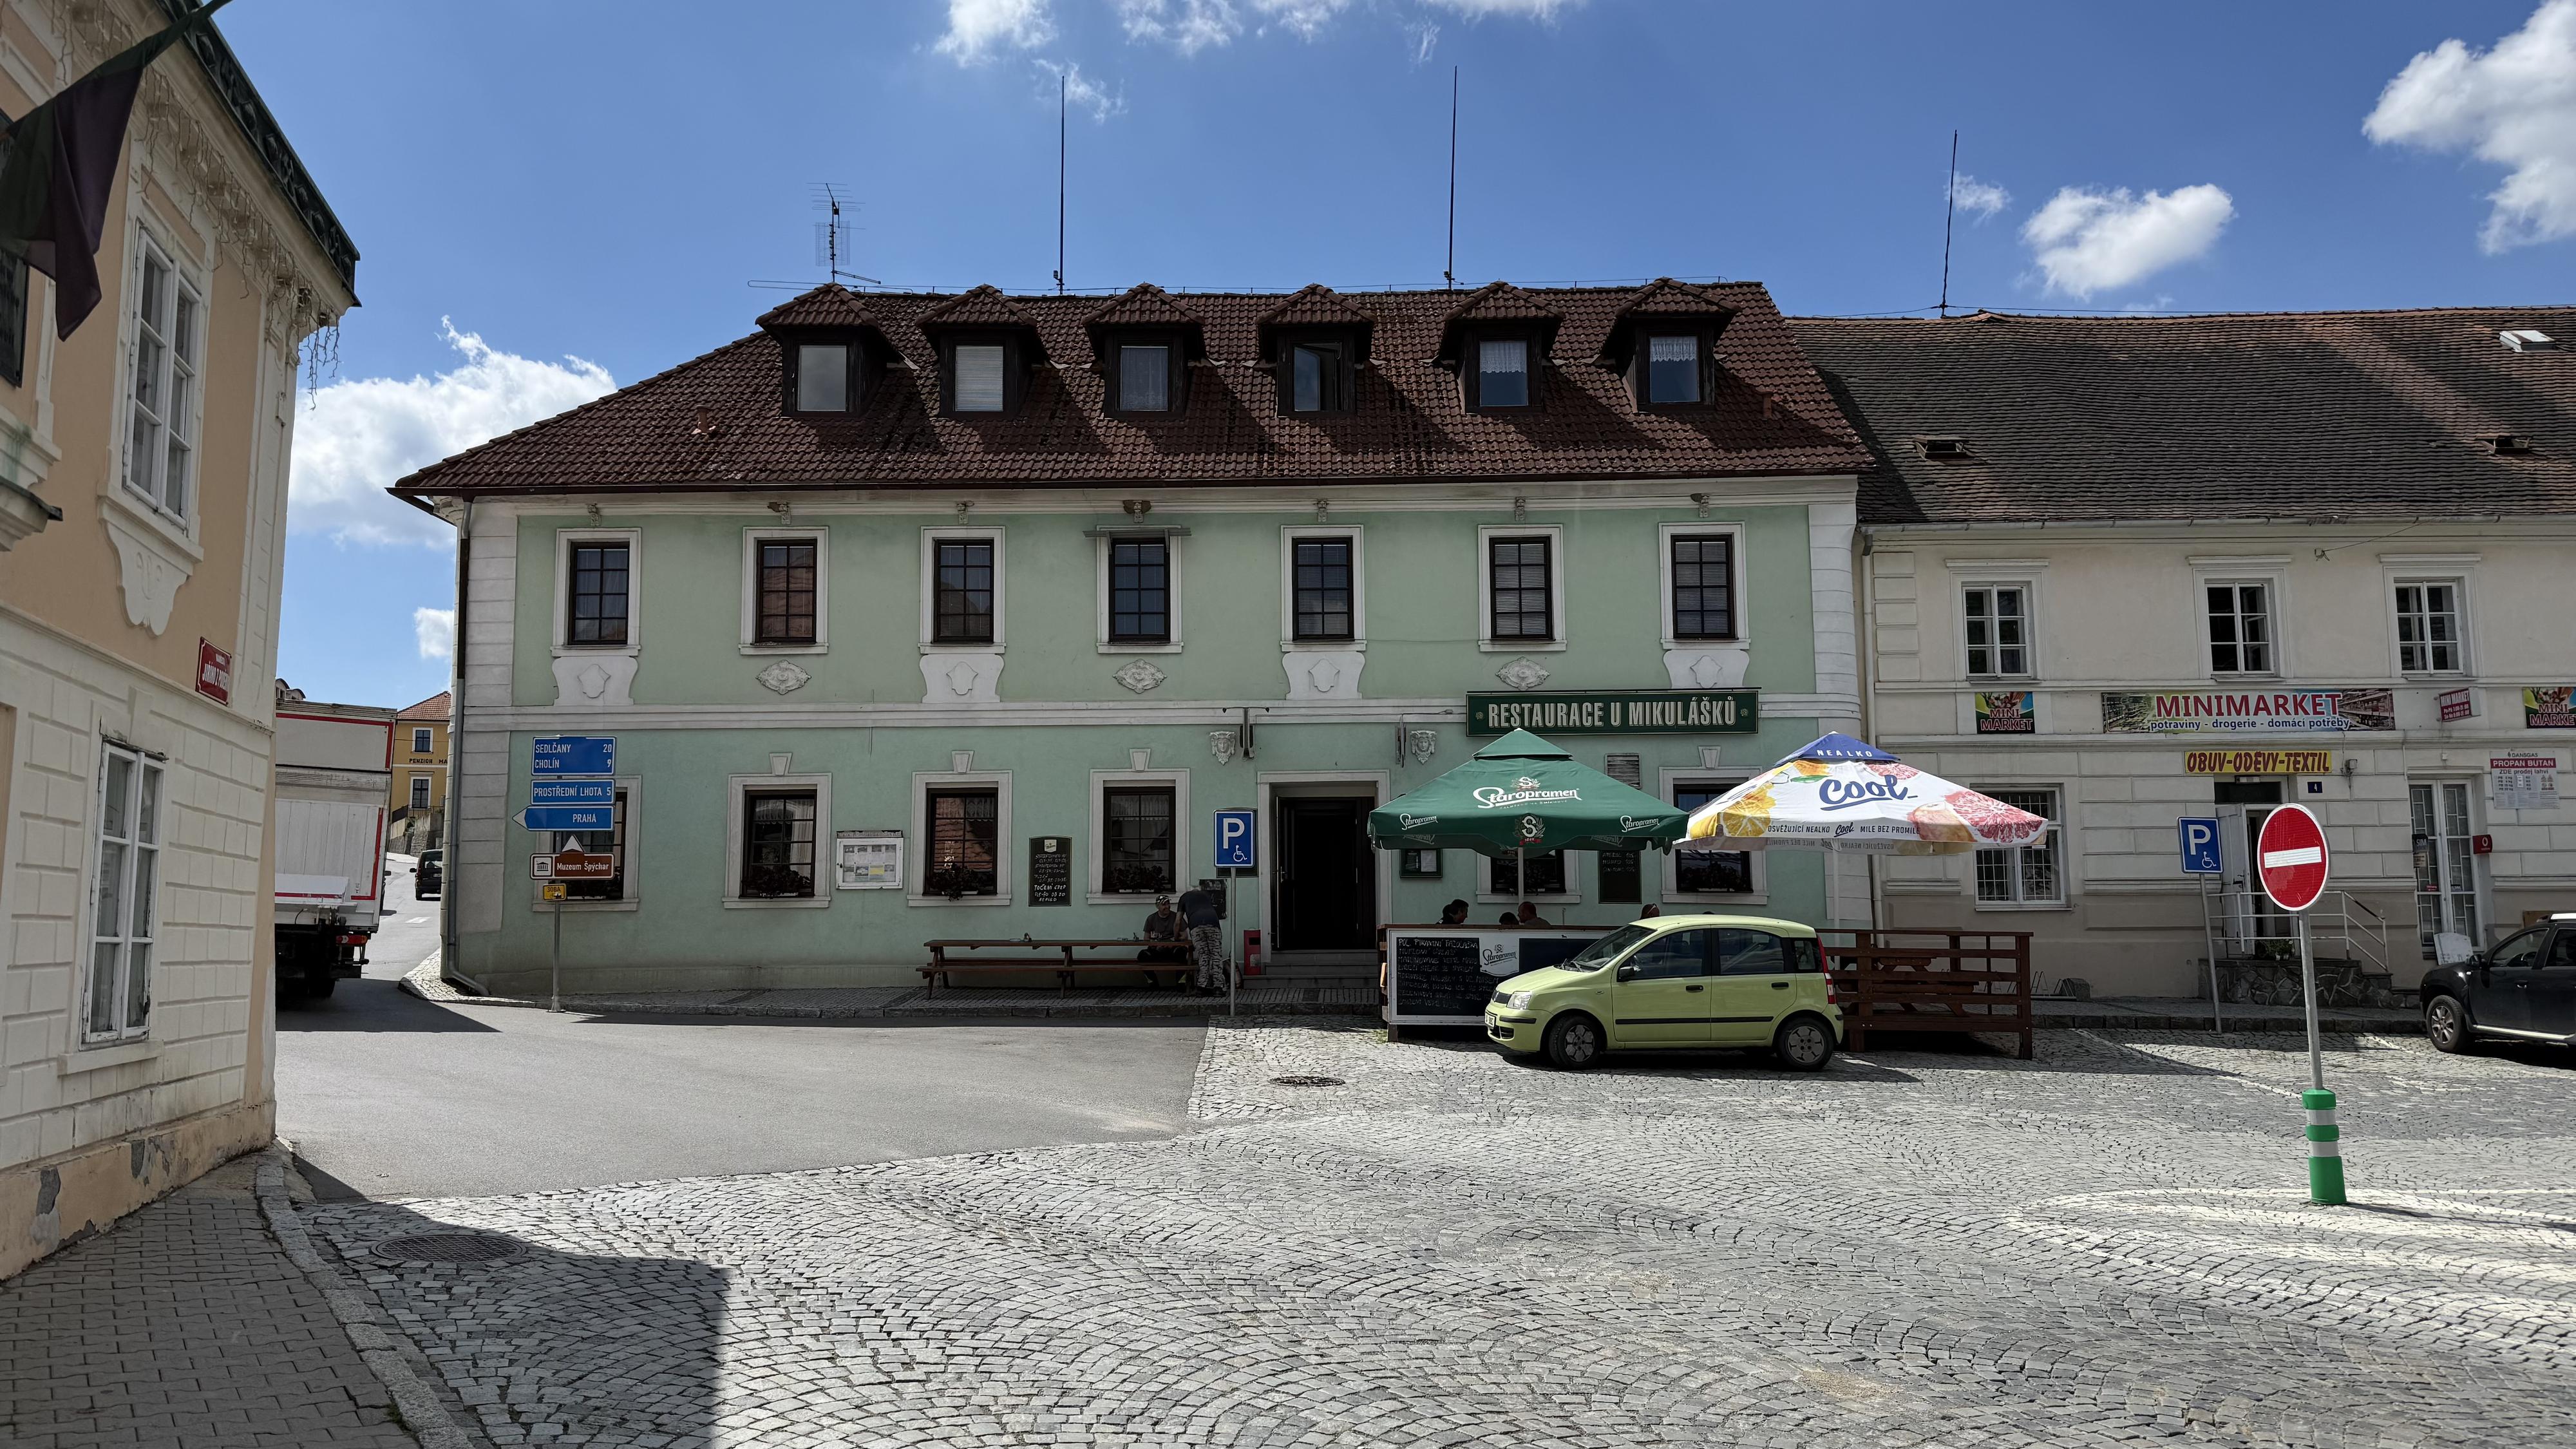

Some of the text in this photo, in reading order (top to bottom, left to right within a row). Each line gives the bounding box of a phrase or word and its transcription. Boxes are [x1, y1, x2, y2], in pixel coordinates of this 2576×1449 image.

[1488, 696, 1736, 728] RESTAURACE U MIKULÁŠKŮ
[2155, 693, 2342, 718] MINIMARKET
[2538, 703, 2569, 713] MINI
[1990, 708, 2020, 718] MINI
[1980, 719, 2032, 730] MARKET
[2150, 718, 2201, 731] potraviny
[2211, 718, 2257, 730] drogerie
[2268, 717, 2306, 728] domácí
[2309, 717, 2350, 731] potřeby
[535, 742, 612, 753] SEDLČANY 20
[1816, 748, 1873, 758] NEALKO
[535, 757, 612, 768] CHOLÍN 9
[2187, 752, 2330, 772] OBUV-ODĚVY-TEXTIL
[534, 785, 611, 797] PROSTŘEDNÍ LHOTA 5
[1473, 786, 1583, 809] Staropramen
[1819, 774, 1909, 811] Cool
[573, 813, 596, 823] PRAHA
[1400, 813, 1438, 830] Staropramen
[1620, 815, 1660, 832] Staropramen
[1223, 818, 1245, 849] P
[1768, 824, 1804, 834] OSVĚŽUJÍCÍ
[1806, 825, 1830, 833] NEALKO
[2188, 824, 2211, 855] P
[556, 860, 609, 872] Muzeum Špýchar
[1482, 949, 1518, 965] Staropramen
